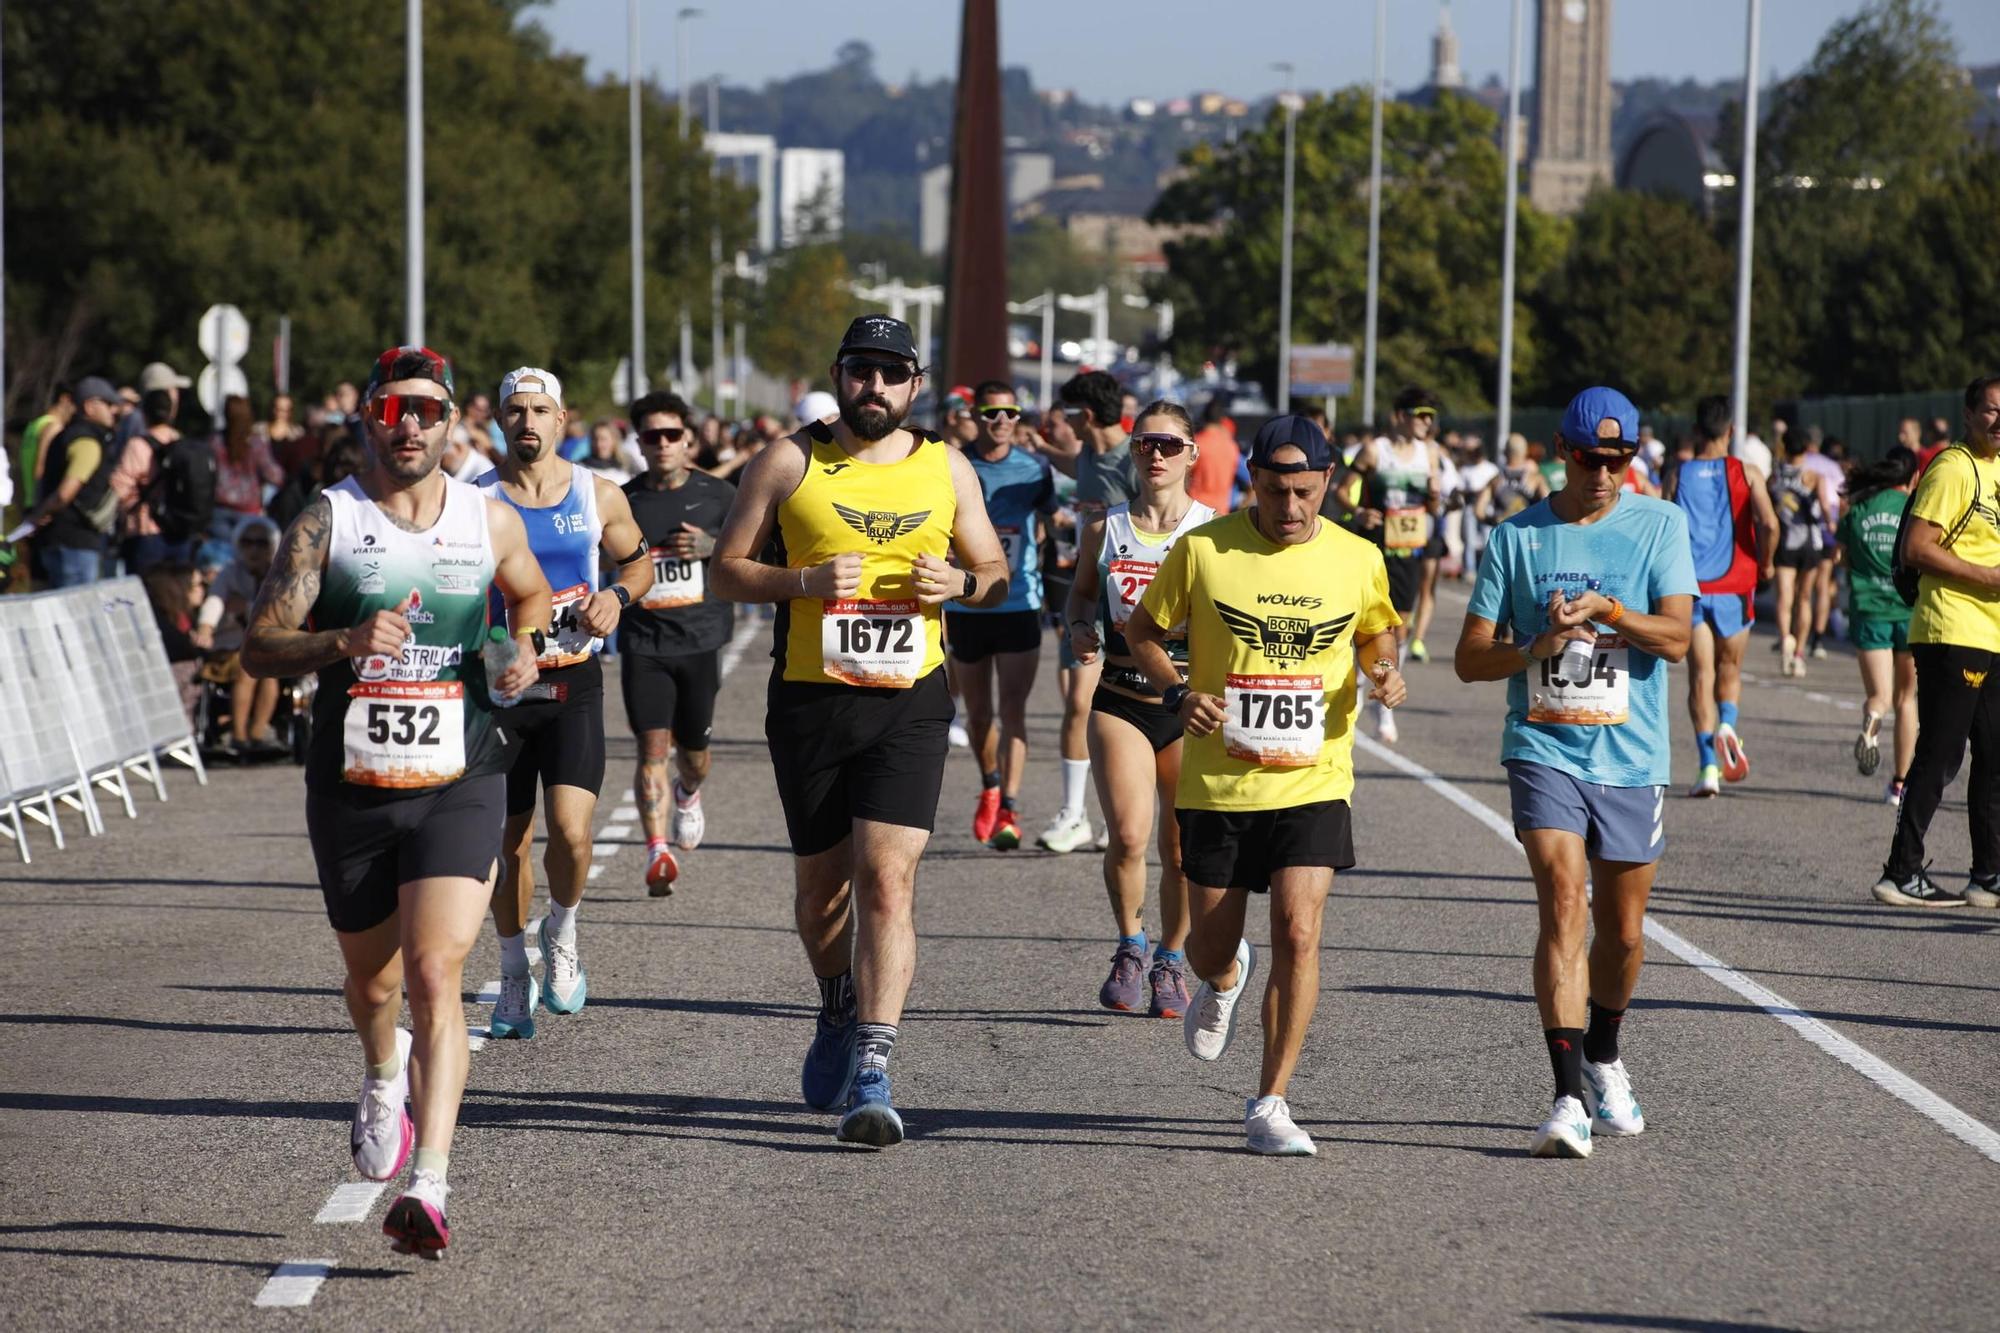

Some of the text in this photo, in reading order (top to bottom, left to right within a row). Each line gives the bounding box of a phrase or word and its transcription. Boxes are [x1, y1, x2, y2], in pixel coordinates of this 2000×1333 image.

[870, 512, 895, 521] BORN
[868, 527, 894, 537] RUN
[353, 547, 387, 555] VIATOR
[655, 559, 692, 583] 160
[1554, 573, 1590, 582] MBA
[1256, 593, 1323, 610] WOLVES
[1269, 619, 1307, 632] BORN
[836, 619, 913, 653] 1672
[1278, 632, 1295, 643] TO
[1267, 644, 1303, 657] RUN
[1239, 693, 1314, 730] 1765
[368, 703, 441, 745] 532
